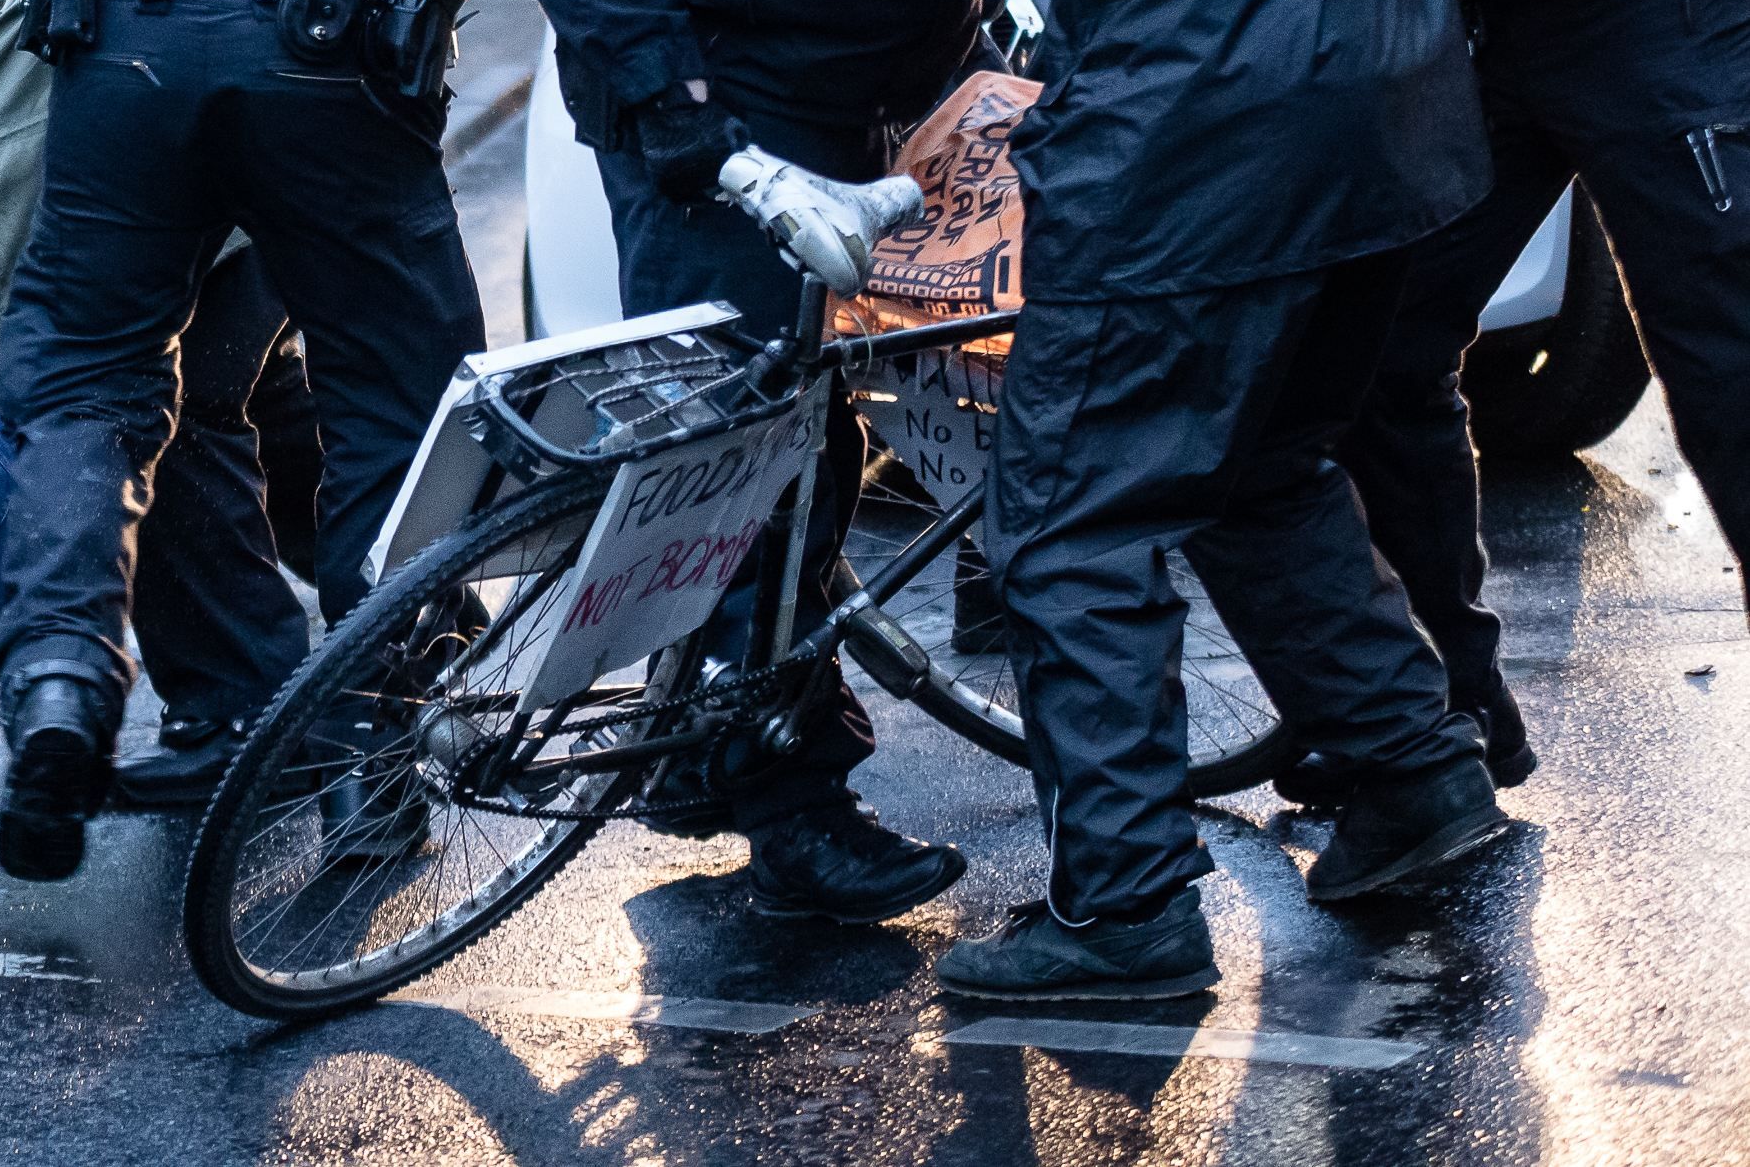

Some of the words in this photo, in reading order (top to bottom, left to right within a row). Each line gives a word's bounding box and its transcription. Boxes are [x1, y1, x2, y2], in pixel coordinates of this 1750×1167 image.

[906, 408, 952, 444] No
[617, 445, 744, 534] FOOD
[919, 450, 966, 484] No
[562, 555, 652, 634] NOT
[637, 518, 765, 603] BOMB
